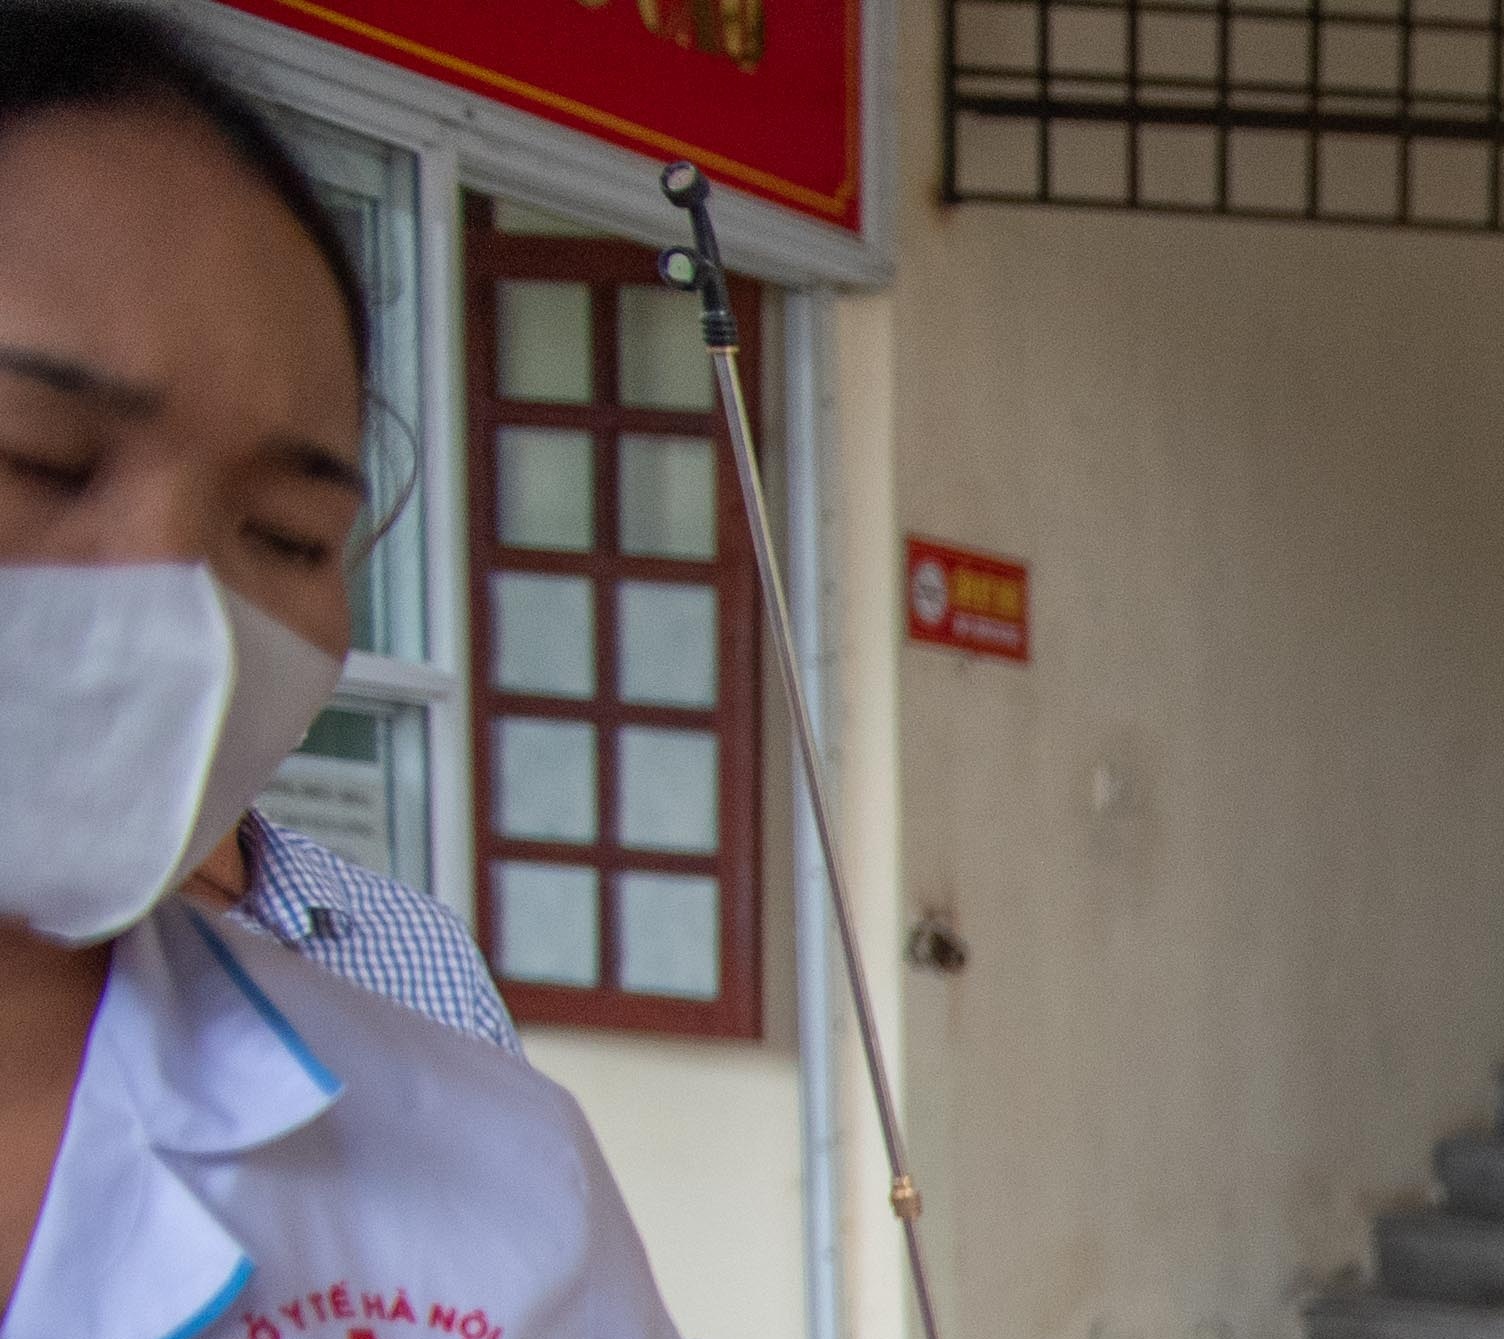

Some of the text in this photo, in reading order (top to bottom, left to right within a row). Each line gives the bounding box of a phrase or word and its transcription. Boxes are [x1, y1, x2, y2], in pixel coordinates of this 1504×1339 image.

[280, 1300, 306, 1330] Y
[309, 1280, 355, 1322] TẾ
[361, 1286, 417, 1324] HÀ
